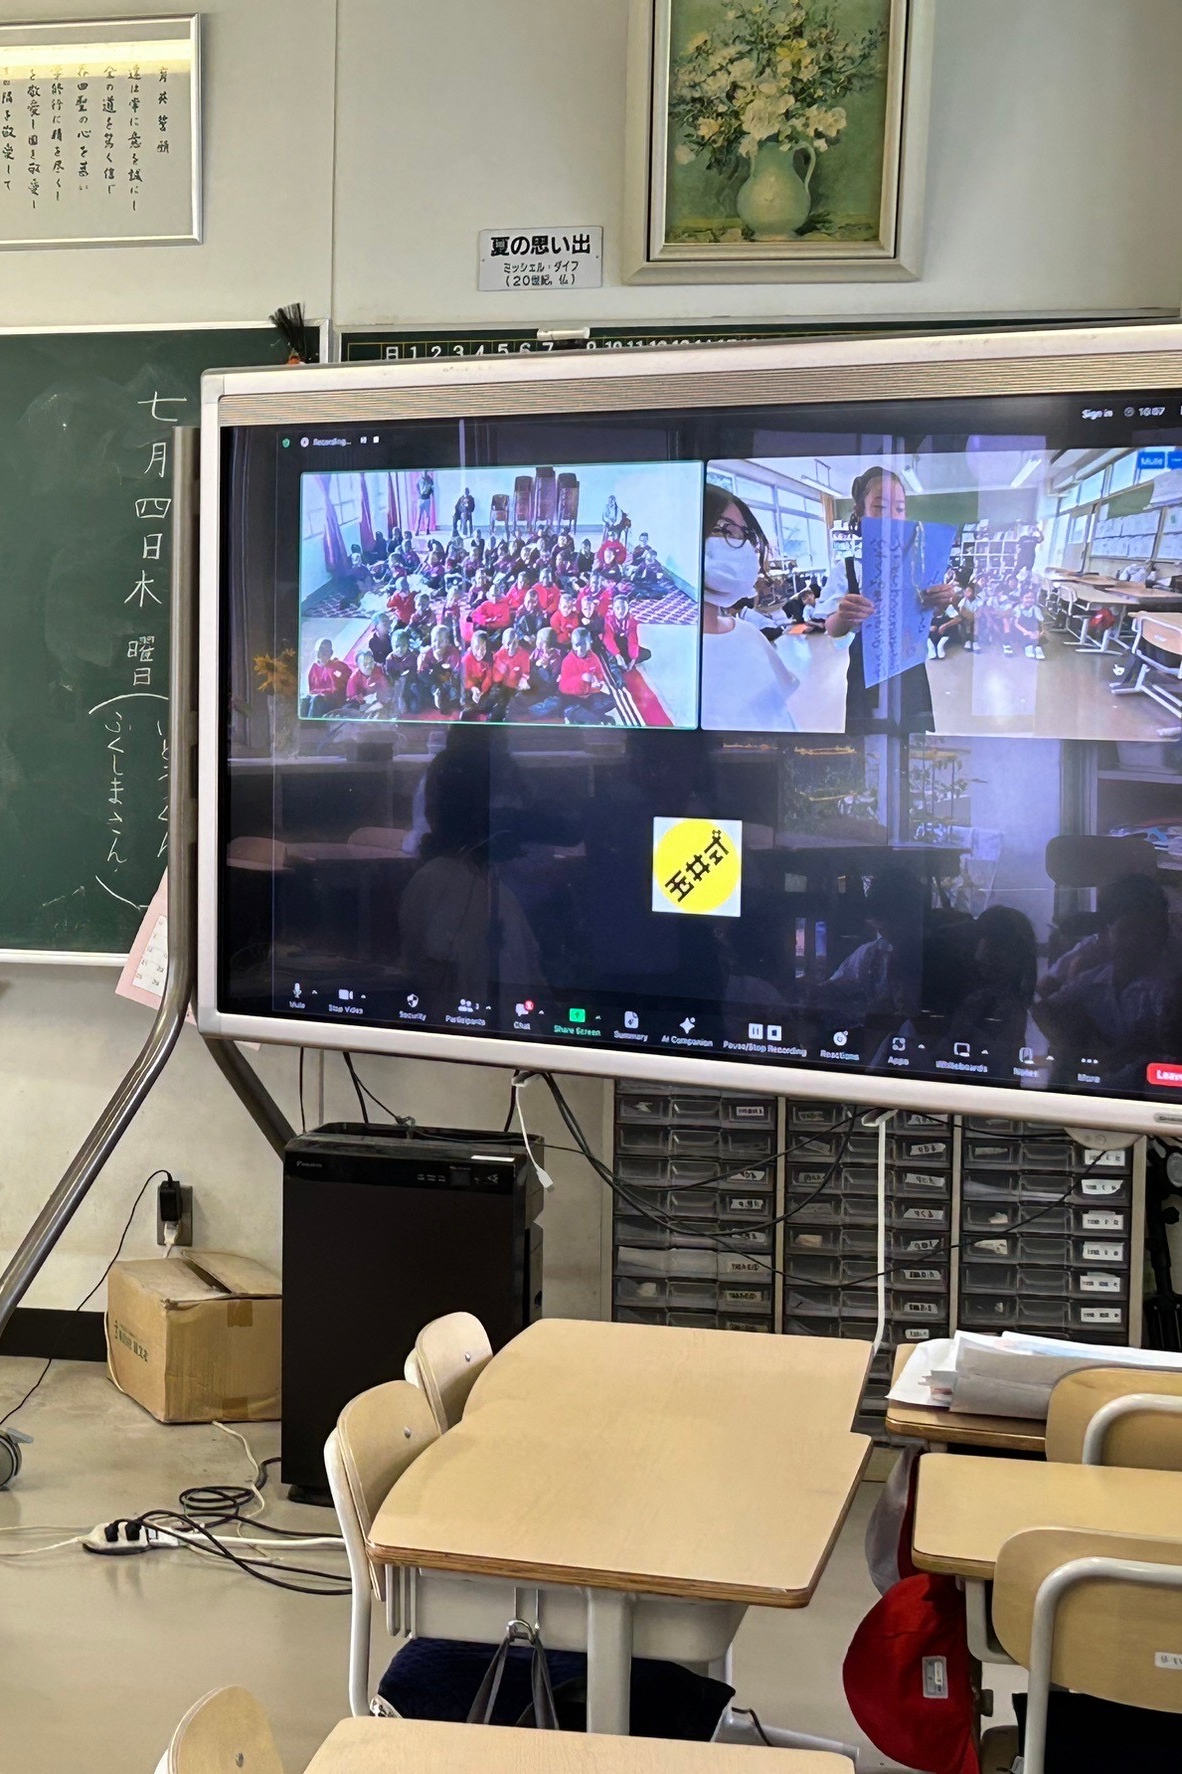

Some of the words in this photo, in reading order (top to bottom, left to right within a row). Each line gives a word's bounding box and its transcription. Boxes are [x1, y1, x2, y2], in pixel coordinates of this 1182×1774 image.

[490, 233, 591, 257] 夏の思い出
[410, 346, 417, 359] 1
[430, 345, 442, 358] 2
[452, 344, 464, 356] 3
[475, 344, 484, 355] 4
[497, 343, 509, 355] 5
[542, 342, 554, 353] 7
[124, 391, 187, 686] 七月四日木曜日
[664, 830, 729, 903] 玉井式
[399, 1011, 427, 1021] Security
[445, 1015, 486, 1026] Participants
[513, 1021, 531, 1030] Chat
[553, 1025, 575, 1035] Share
[576, 1028, 602, 1037] Screen
[613, 1030, 648, 1042] Summary
[670, 1036, 714, 1047] Companion
[723, 1040, 767, 1053] Pause/Stop
[767, 1047, 807, 1058] Recording
[820, 1050, 860, 1061] Reactions
[1156, 1069, 1182, 1081] Leav
